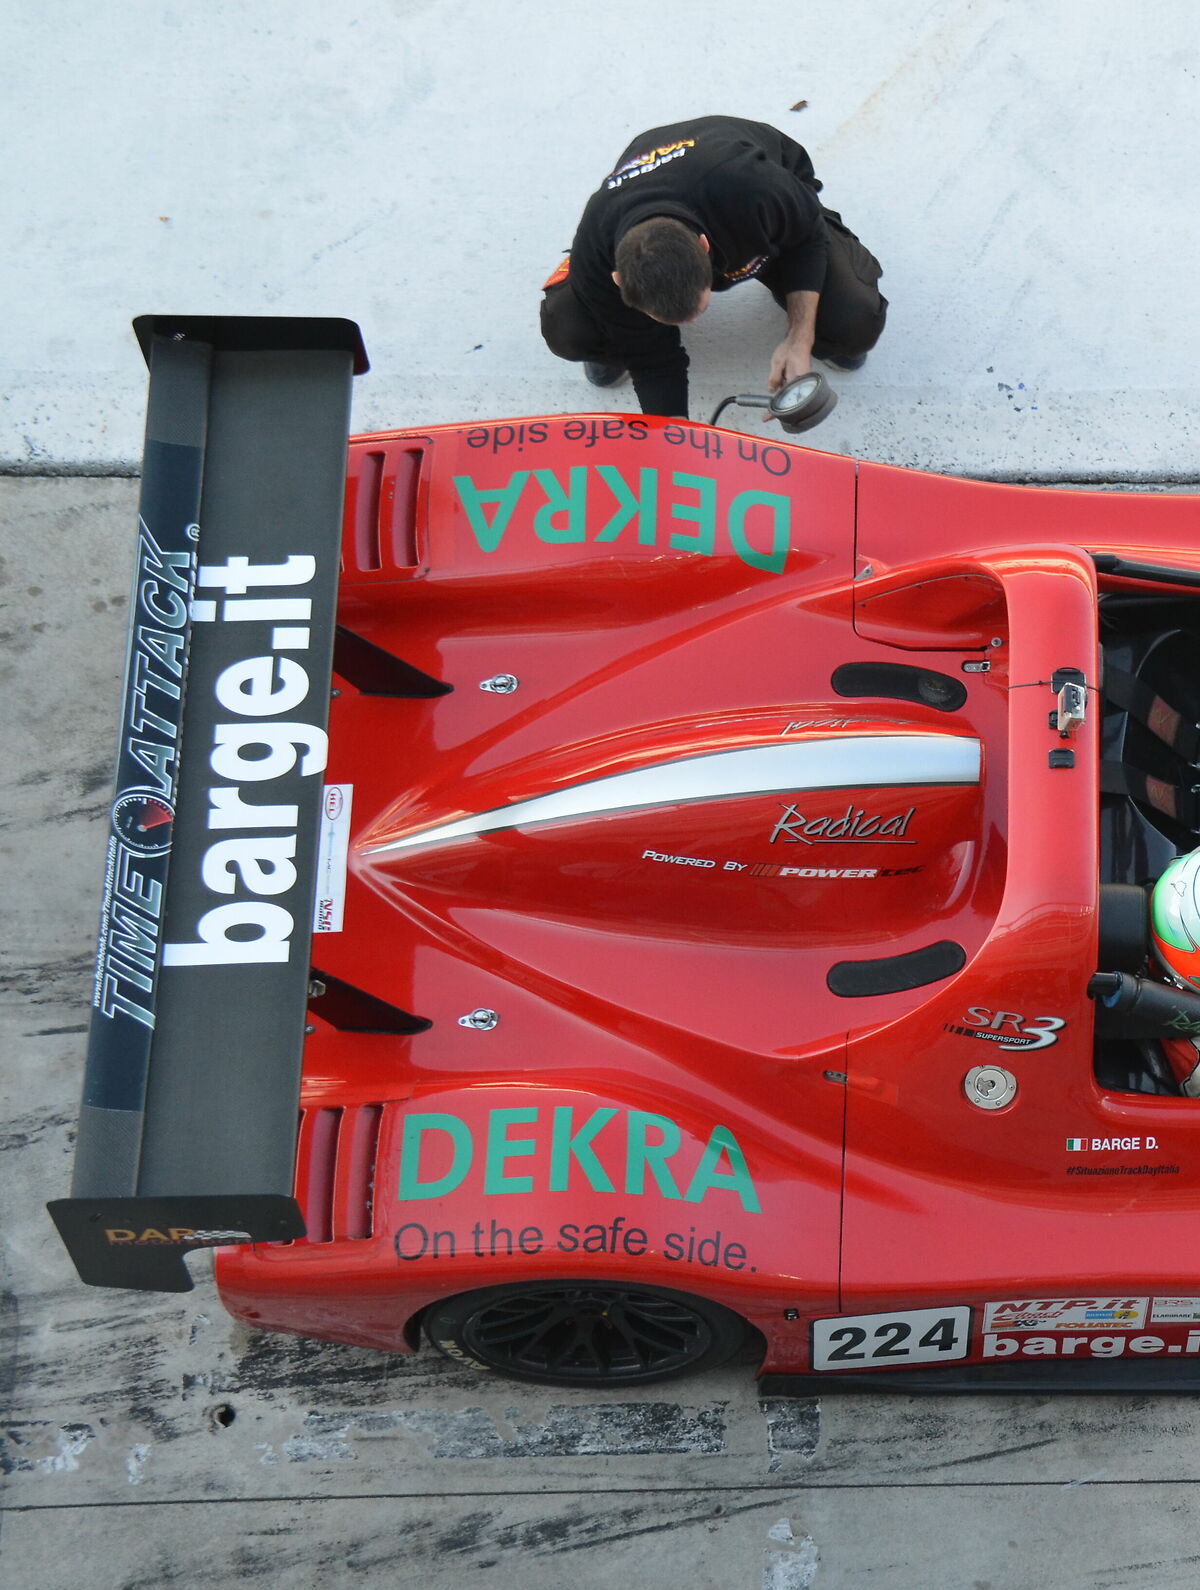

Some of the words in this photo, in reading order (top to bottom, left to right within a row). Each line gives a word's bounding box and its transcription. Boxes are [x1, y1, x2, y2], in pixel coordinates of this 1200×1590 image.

[457, 422, 548, 454] side.
[563, 420, 649, 448] safe
[664, 424, 724, 459] the
[738, 446, 791, 476] On
[452, 465, 791, 575] DEKRA
[127, 513, 190, 794] ATTACK
[163, 555, 328, 966] barge.it
[762, 803, 917, 845] Radical
[102, 843, 162, 1029] TIME
[975, 1031, 1032, 1045] SUPERSPORT
[398, 1106, 762, 1214] DEKRA
[1091, 1137, 1140, 1150] BARGE
[1145, 1137, 1159, 1149] D.
[394, 1223, 456, 1261] On
[472, 1219, 543, 1257] the
[557, 1217, 648, 1256] safe
[663, 1227, 757, 1272] side.
[994, 1299, 1140, 1315] NTP.it
[827, 1318, 958, 1362] 224
